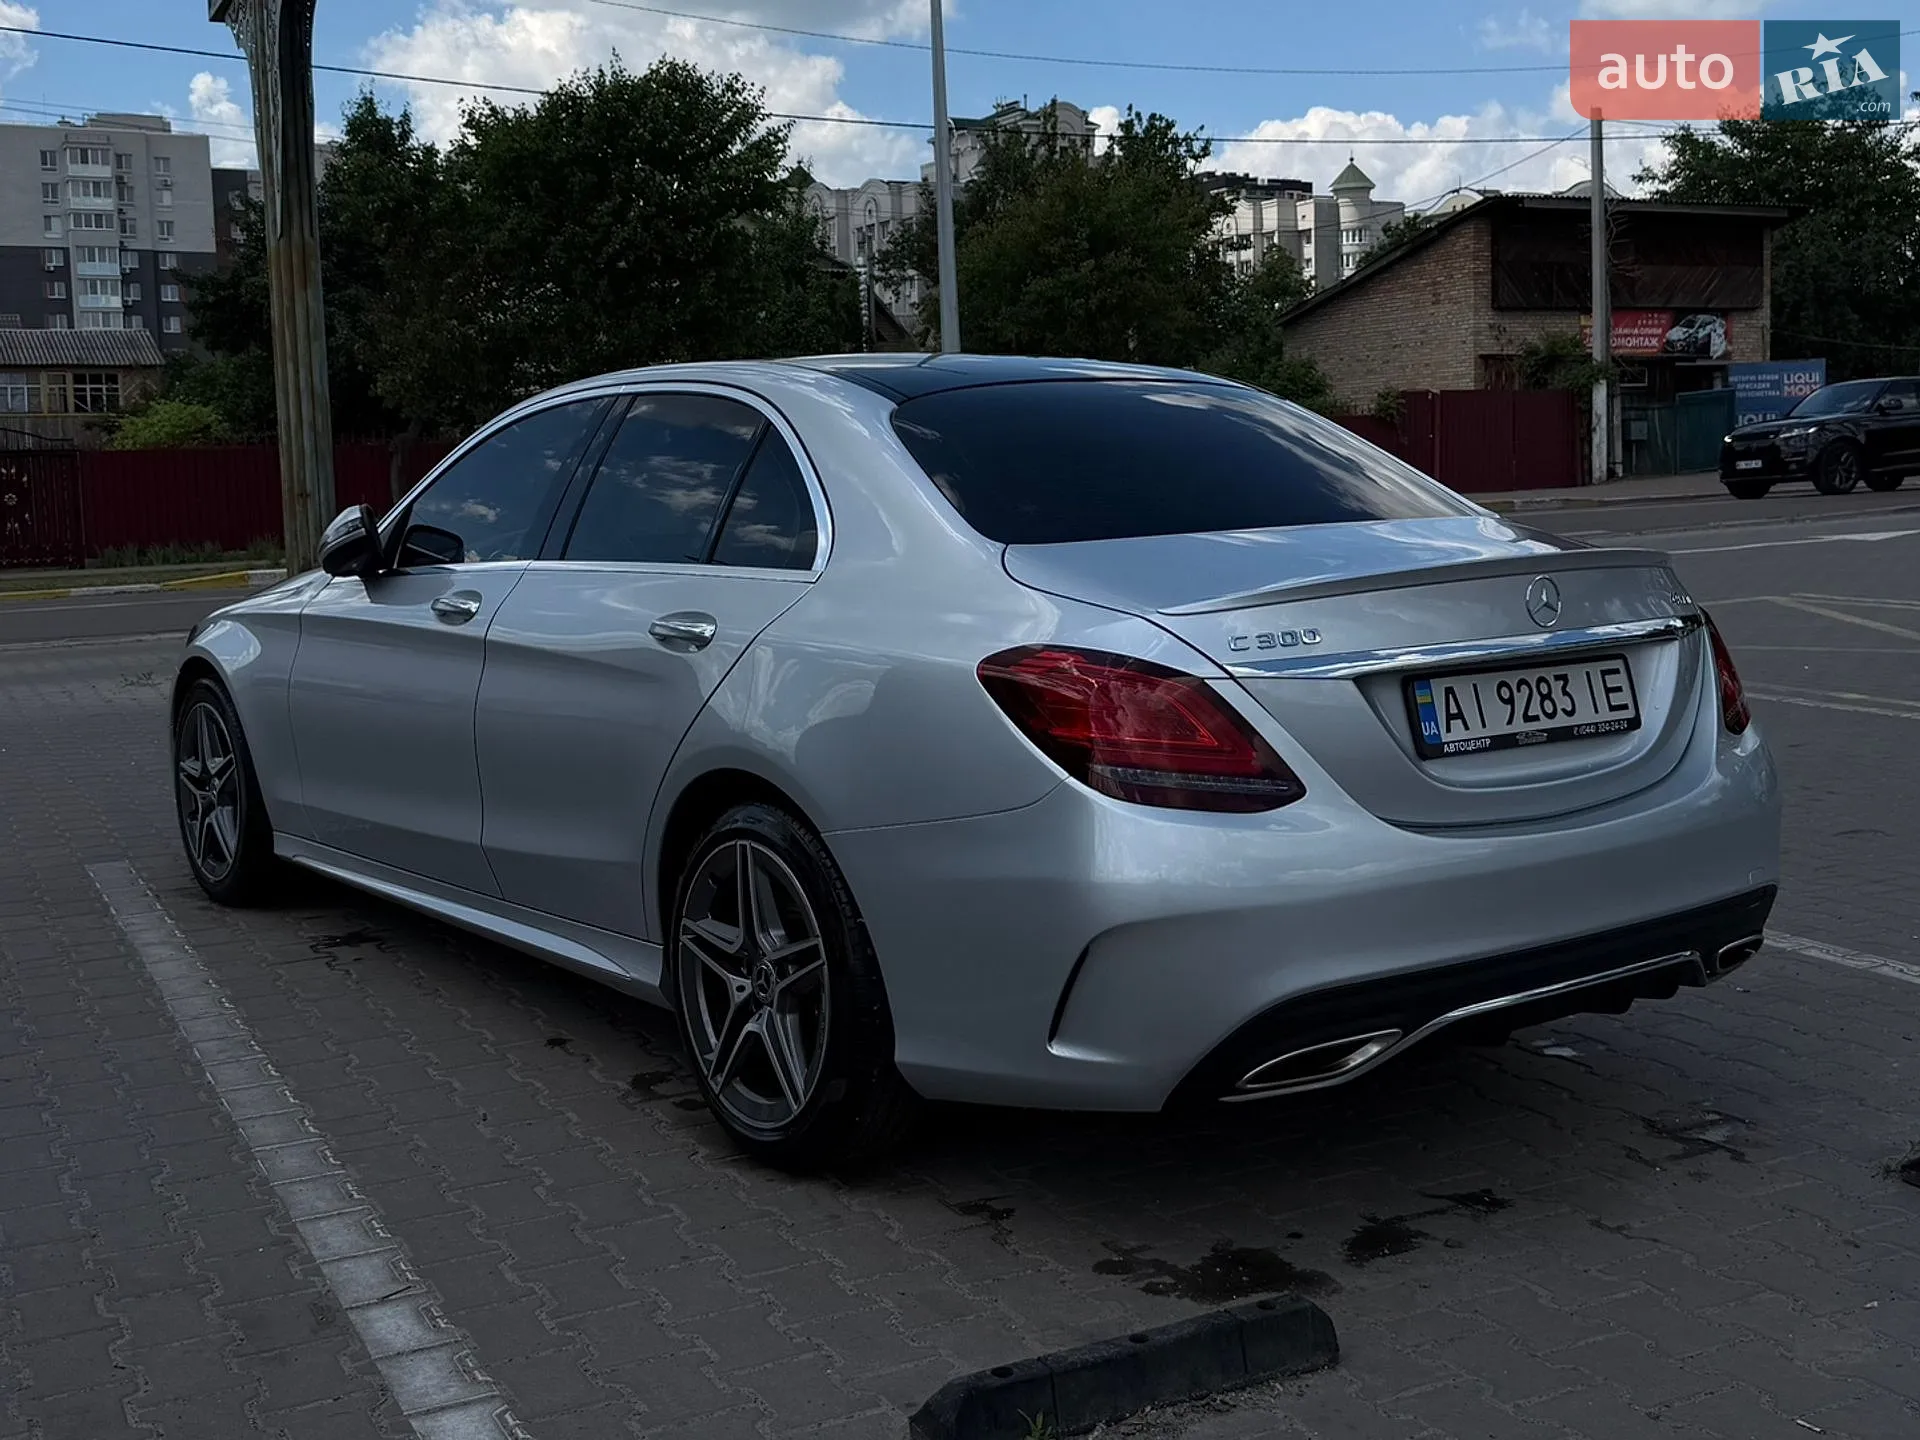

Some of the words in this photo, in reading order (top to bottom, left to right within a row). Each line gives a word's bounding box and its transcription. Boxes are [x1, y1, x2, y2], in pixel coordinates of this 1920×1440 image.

[1783, 372, 1819, 384] LIQUI
[1228, 635, 1250, 651] C
[1255, 628, 1323, 650] 300
[1443, 683, 1487, 734] AI
[1496, 673, 1577, 726] 9283
[1585, 667, 1630, 715] IE
[1421, 721, 1439, 736] UA
[1443, 737, 1491, 753] АВТОЦЕНТР
